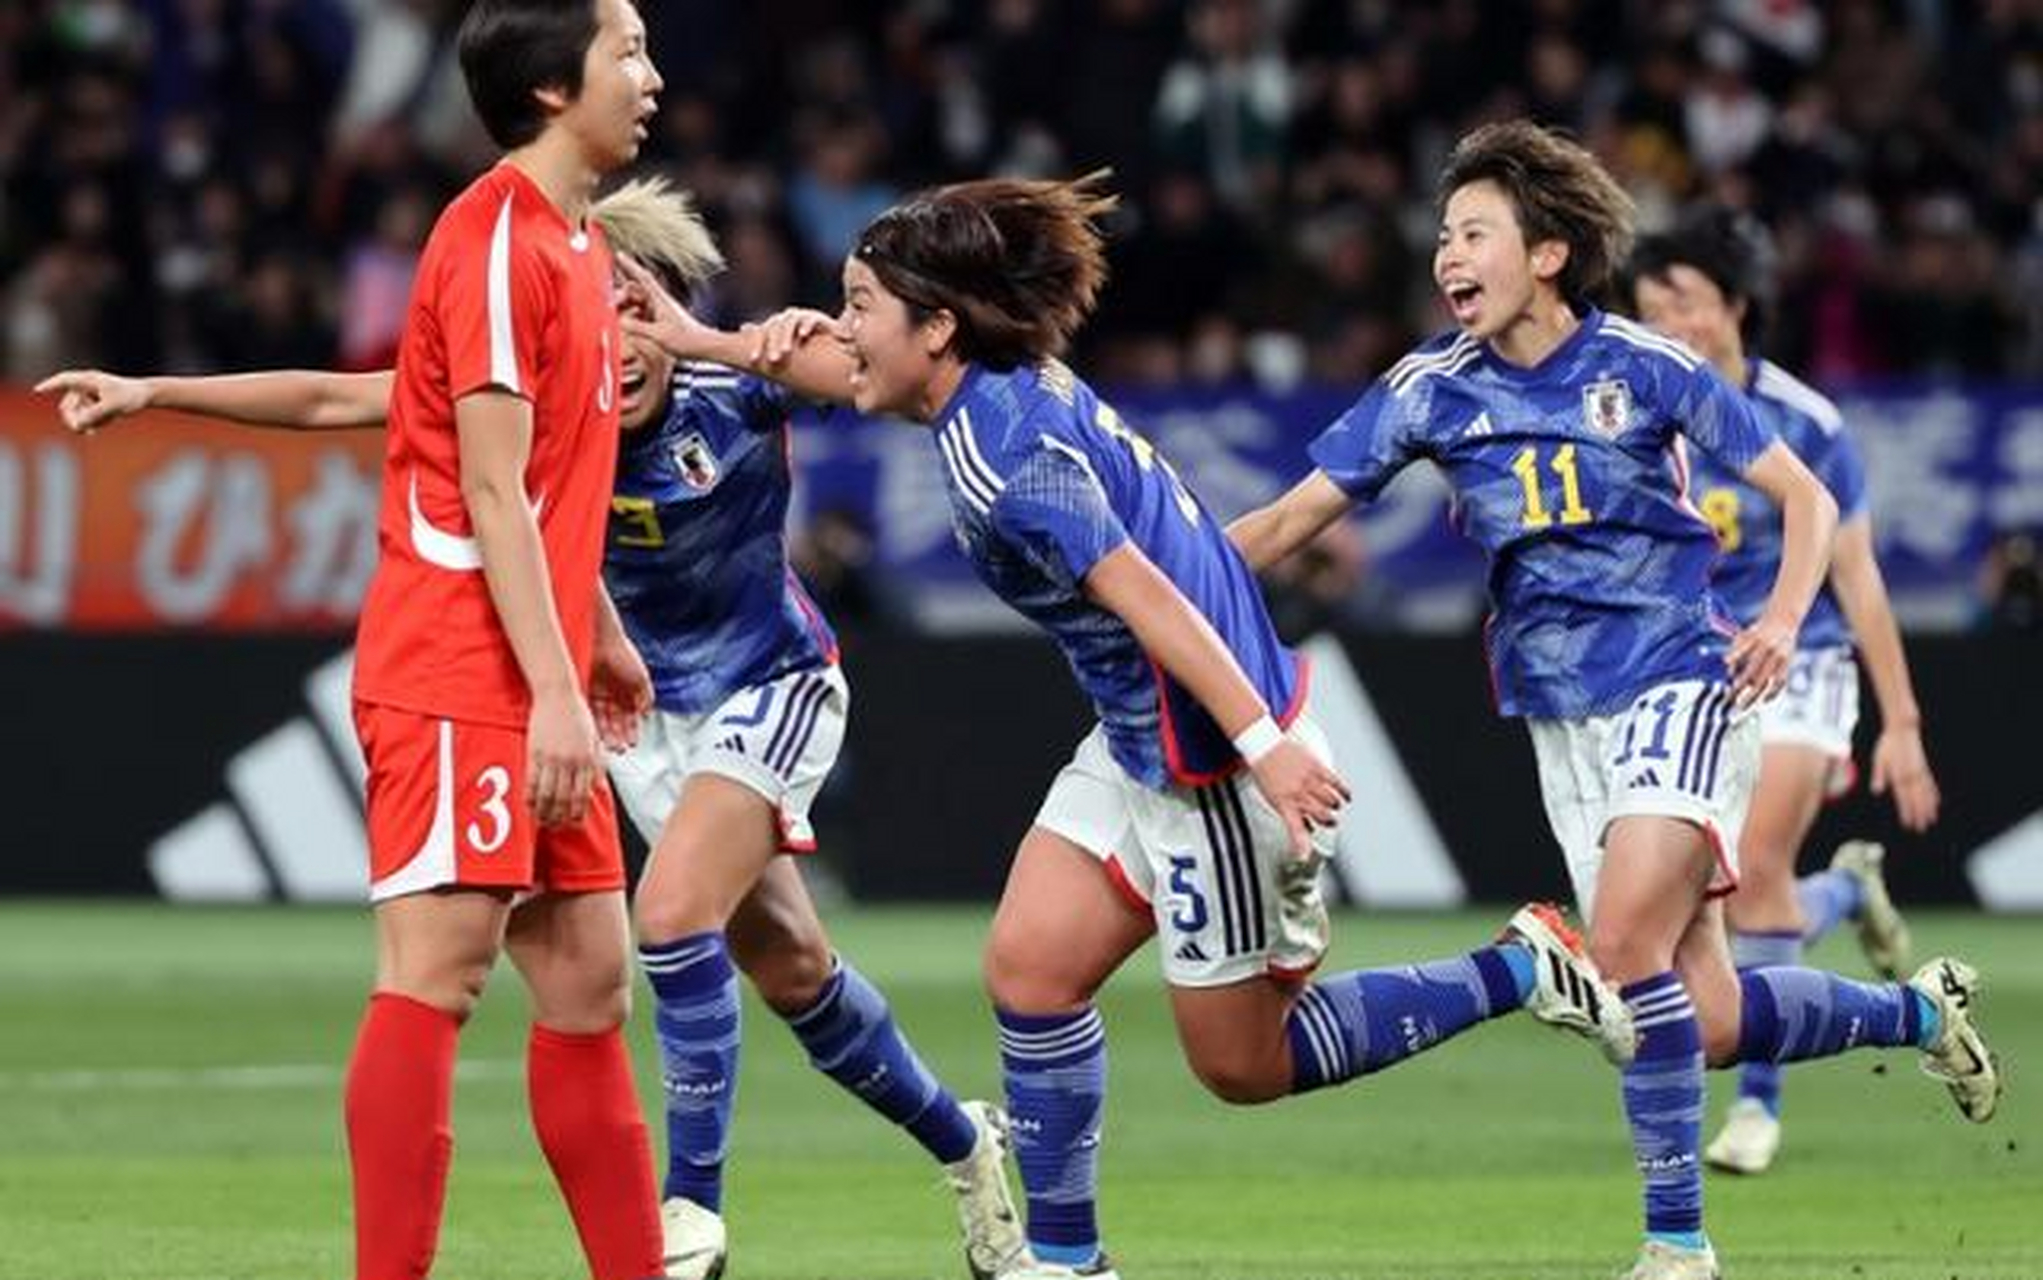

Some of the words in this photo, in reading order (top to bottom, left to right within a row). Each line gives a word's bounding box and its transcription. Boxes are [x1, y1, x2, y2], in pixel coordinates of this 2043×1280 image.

[1510, 443, 1592, 529] 11
[1701, 488, 1741, 553] 8
[1613, 689, 1679, 767] 11
[466, 765, 512, 854] 3
[1168, 856, 1209, 933] 5
